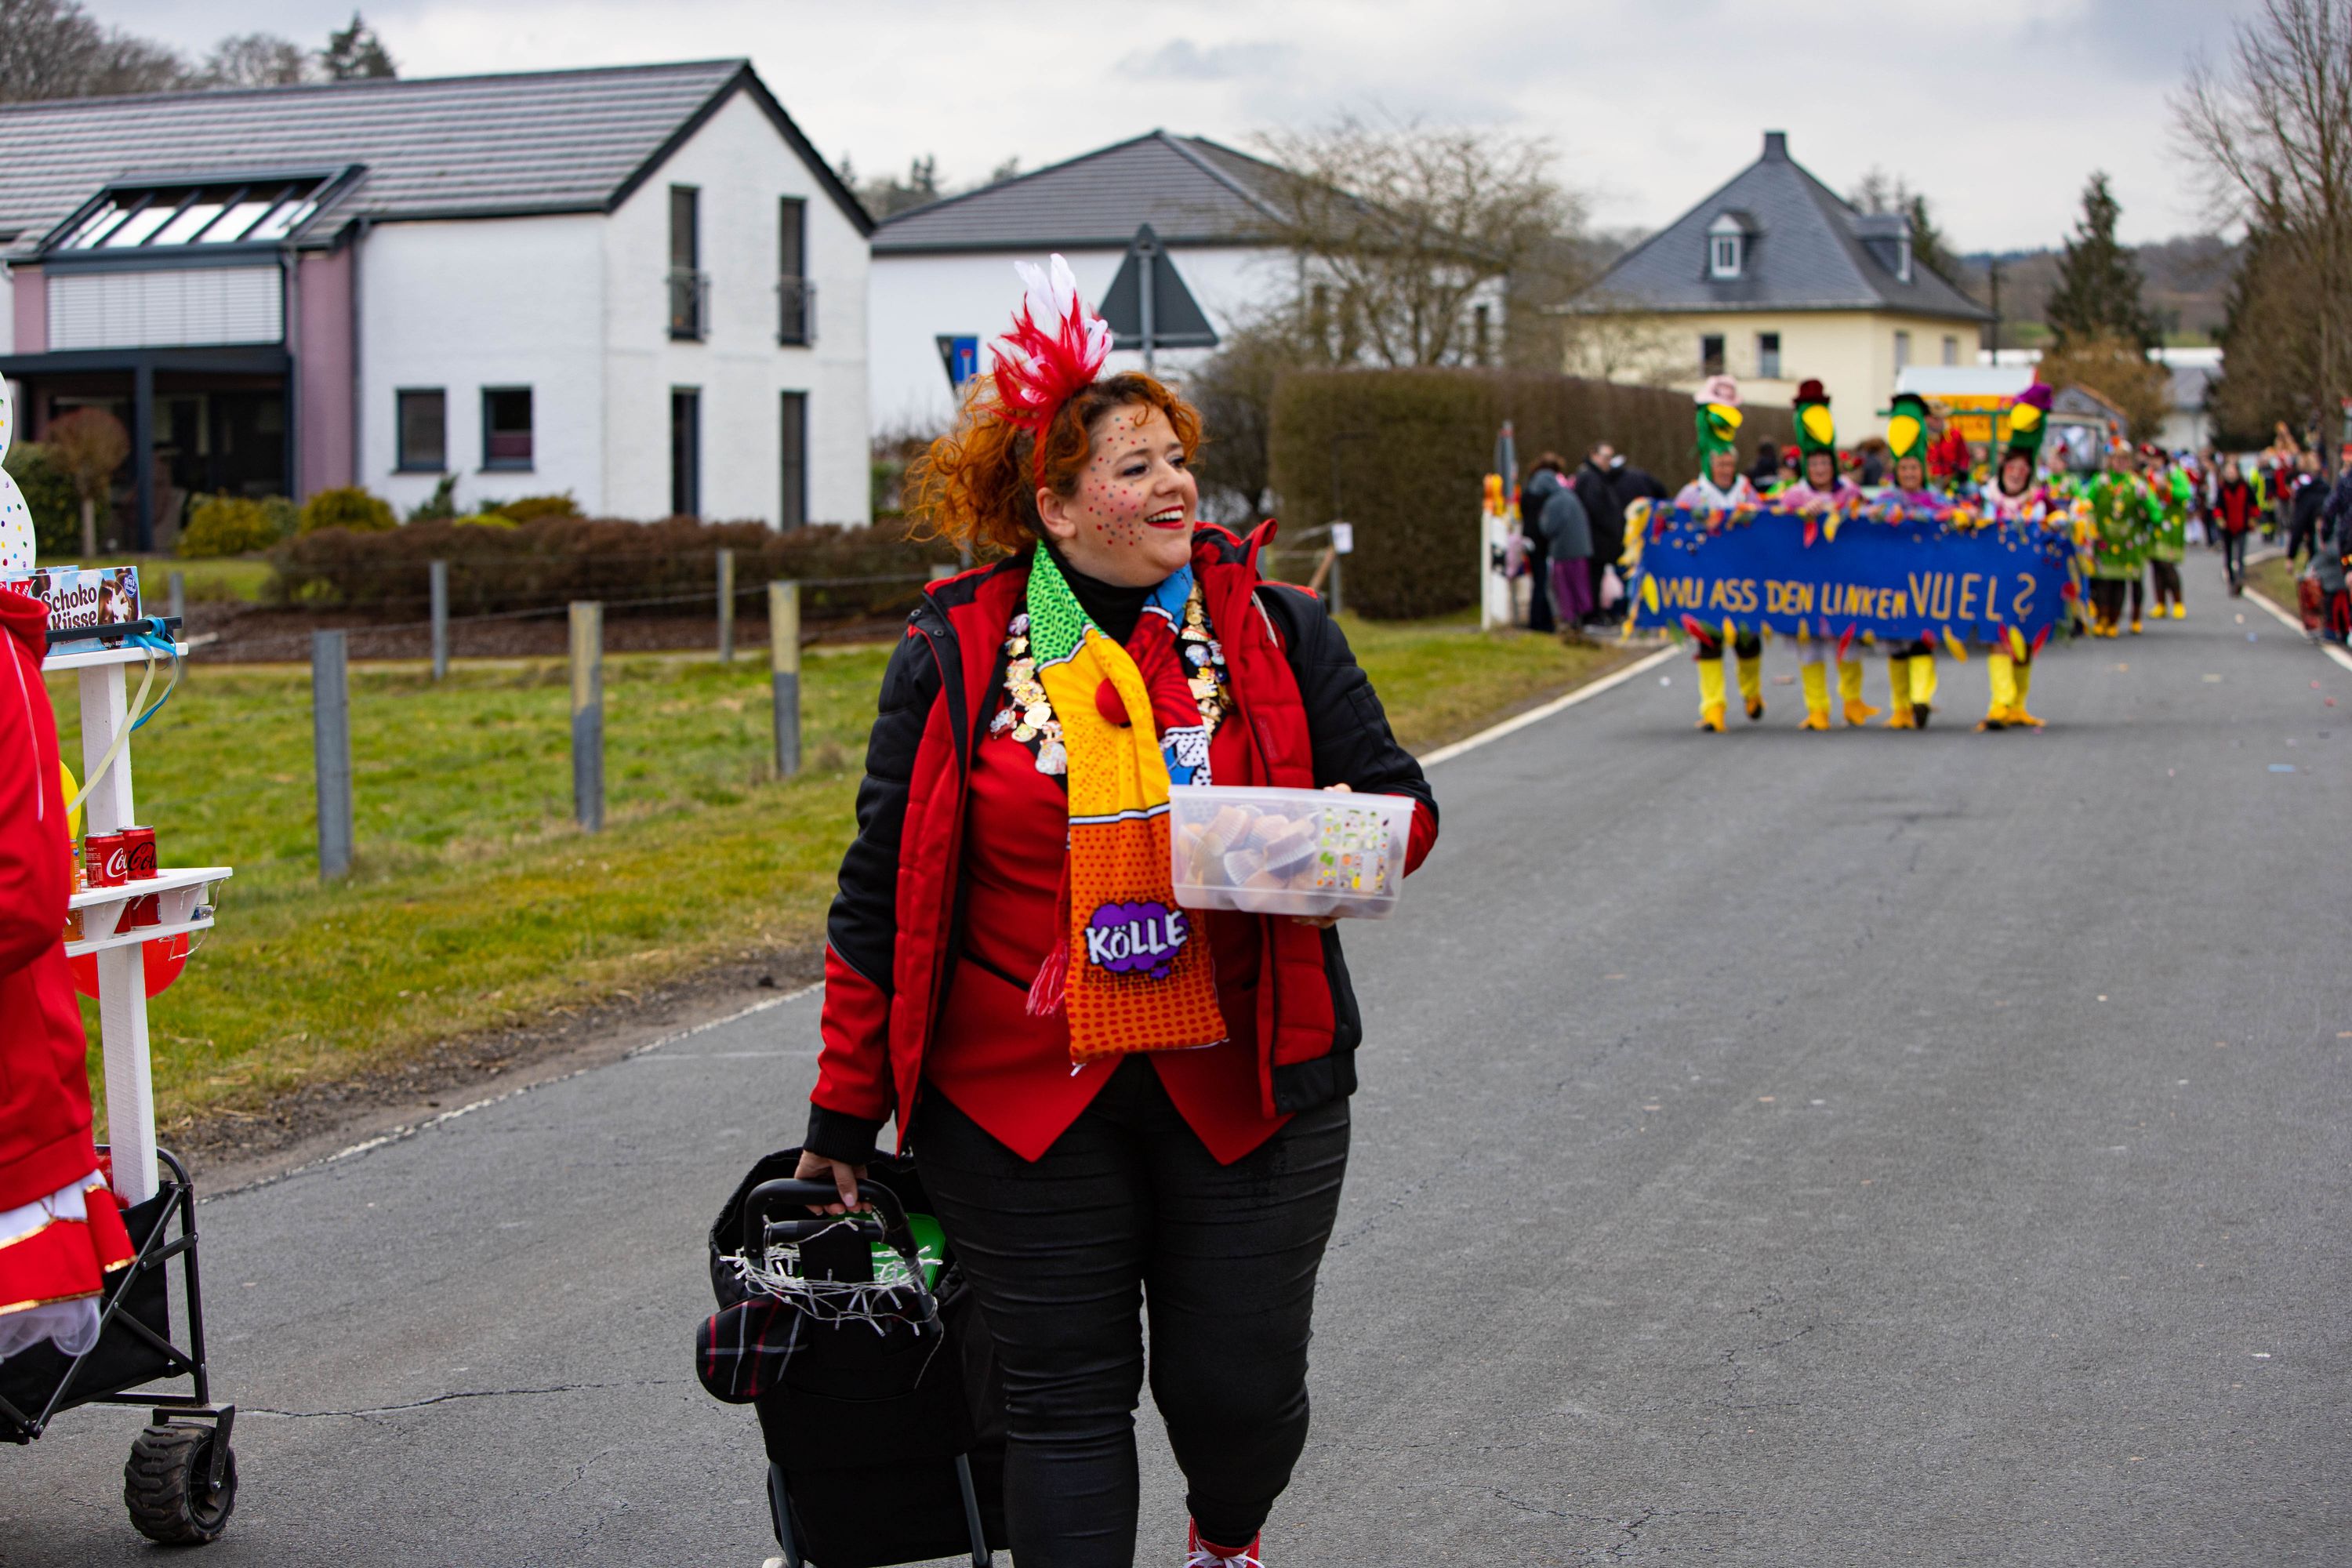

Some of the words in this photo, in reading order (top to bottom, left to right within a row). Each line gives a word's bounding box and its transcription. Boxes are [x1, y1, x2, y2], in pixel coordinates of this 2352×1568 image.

[42, 583, 97, 614] Schoko
[1708, 578, 1759, 613] ASS
[1765, 579, 1814, 615] DEN
[51, 610, 97, 630] Küsse
[1085, 910, 1189, 964] KÖLLE
